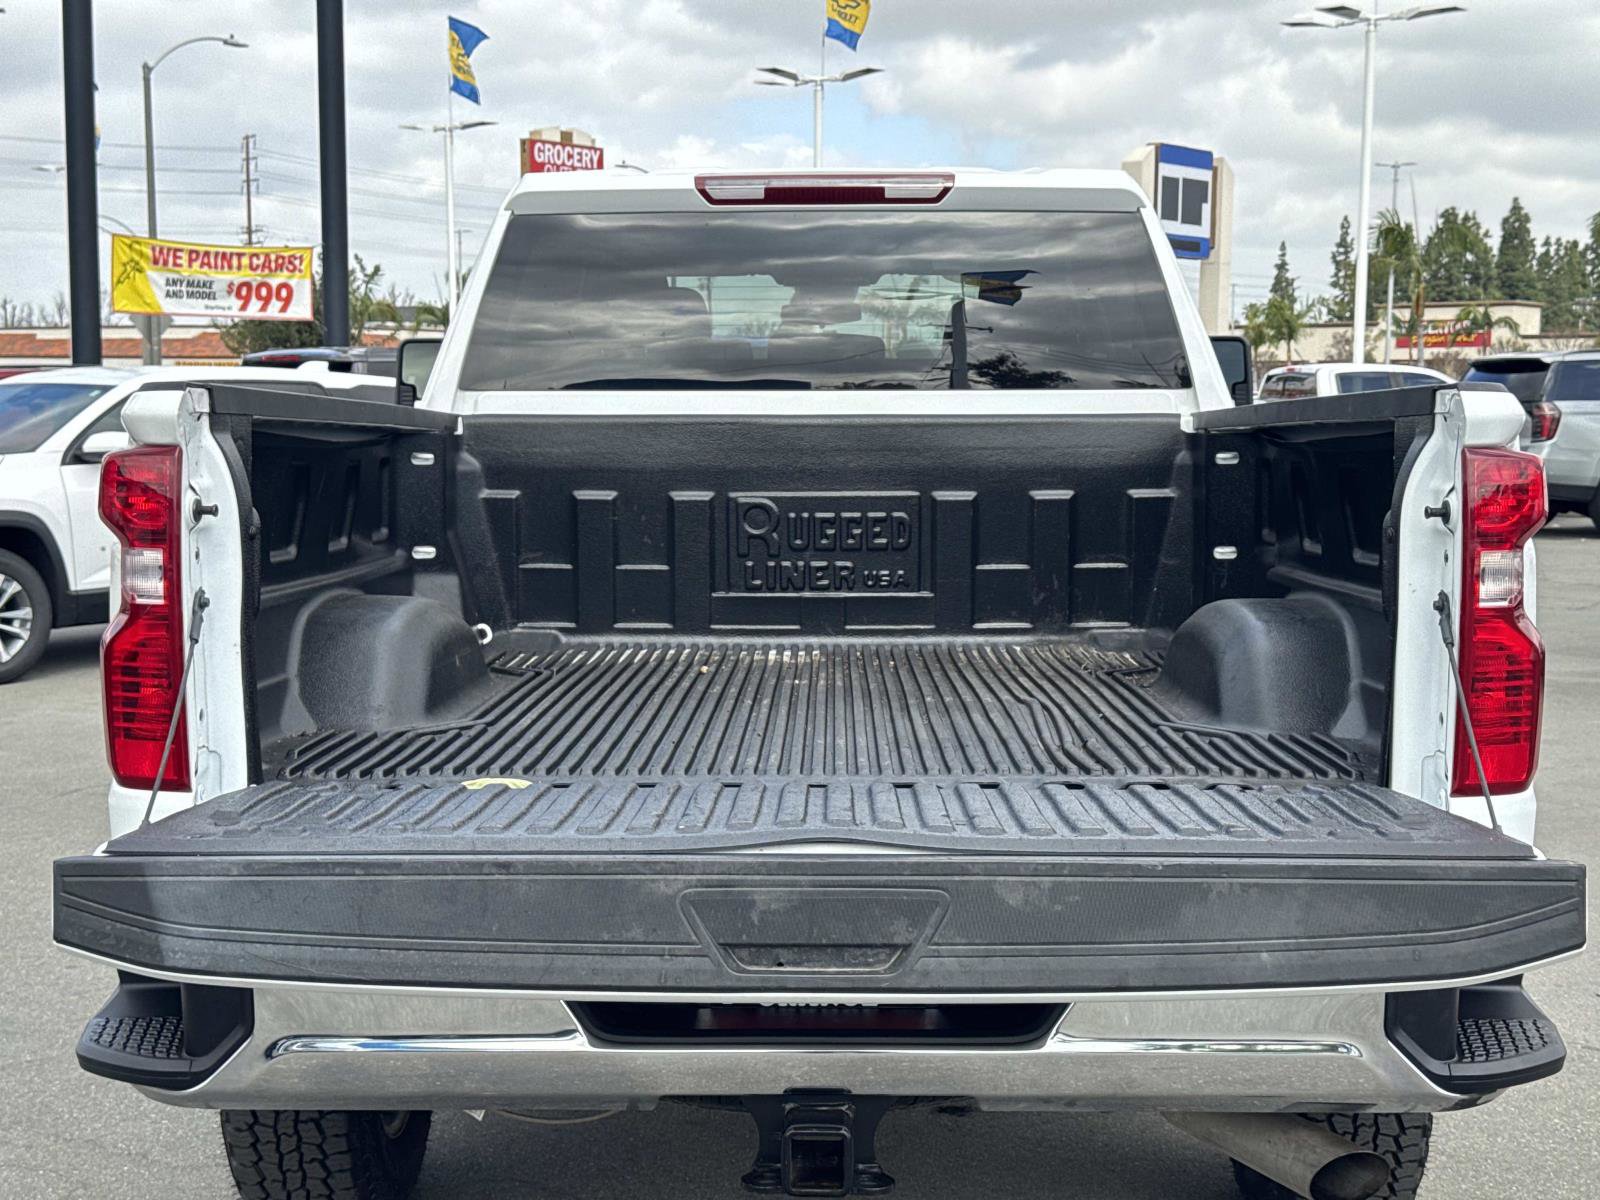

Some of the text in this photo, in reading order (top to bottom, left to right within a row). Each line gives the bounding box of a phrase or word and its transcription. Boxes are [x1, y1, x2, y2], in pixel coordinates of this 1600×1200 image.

[533, 142, 600, 169] GROCERY
[150, 245, 304, 274] WE PAINT CARS!
[165, 277, 215, 290] ANY MAKE
[165, 289, 217, 301] AND MODEL
[226, 280, 294, 313] $999
[736, 496, 912, 558] RUGGED
[744, 560, 910, 591] LINER USA
